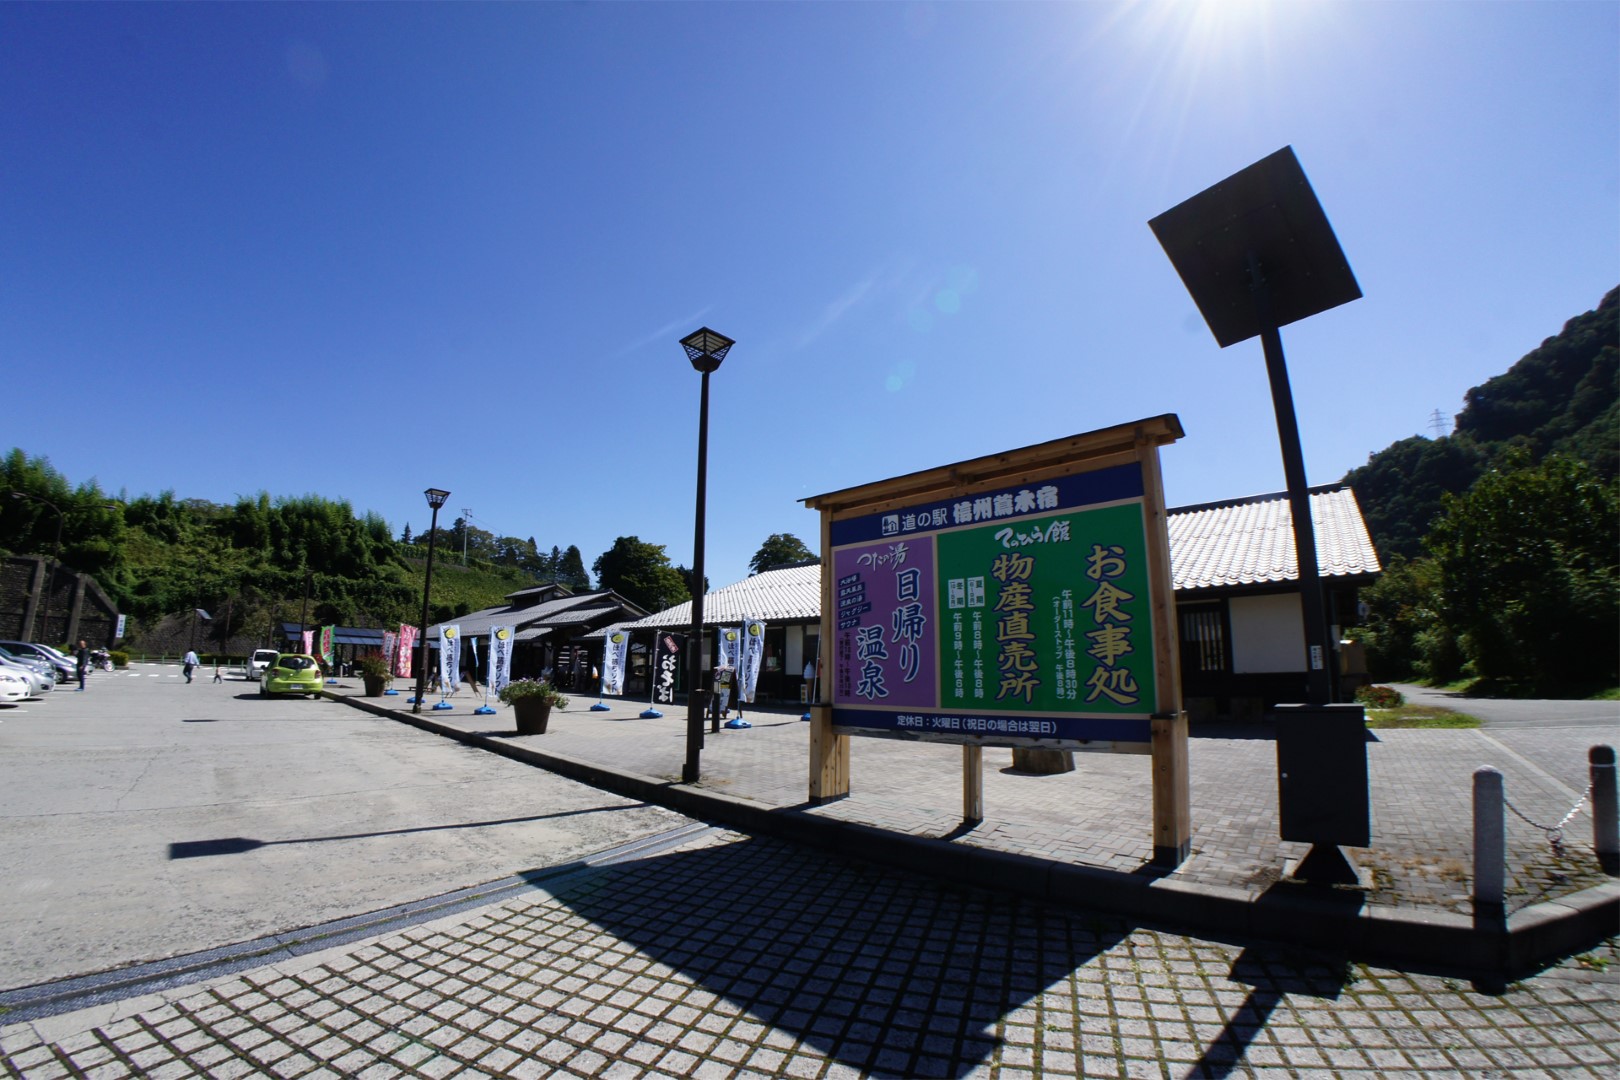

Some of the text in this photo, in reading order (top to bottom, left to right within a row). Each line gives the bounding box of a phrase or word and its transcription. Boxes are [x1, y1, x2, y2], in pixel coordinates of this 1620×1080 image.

[902, 485, 1058, 531] 道の駅 信州蔦木宿
[856, 542, 909, 572] つたの湯
[994, 520, 1071, 549] てのひら館
[840, 605, 868, 618] ジャグジー
[840, 619, 857, 630] サウナ
[891, 567, 927, 683] 日帰り
[991, 552, 1041, 705] 物産直売所
[1080, 544, 1140, 706] お食事処
[855, 624, 889, 700] 温泉
